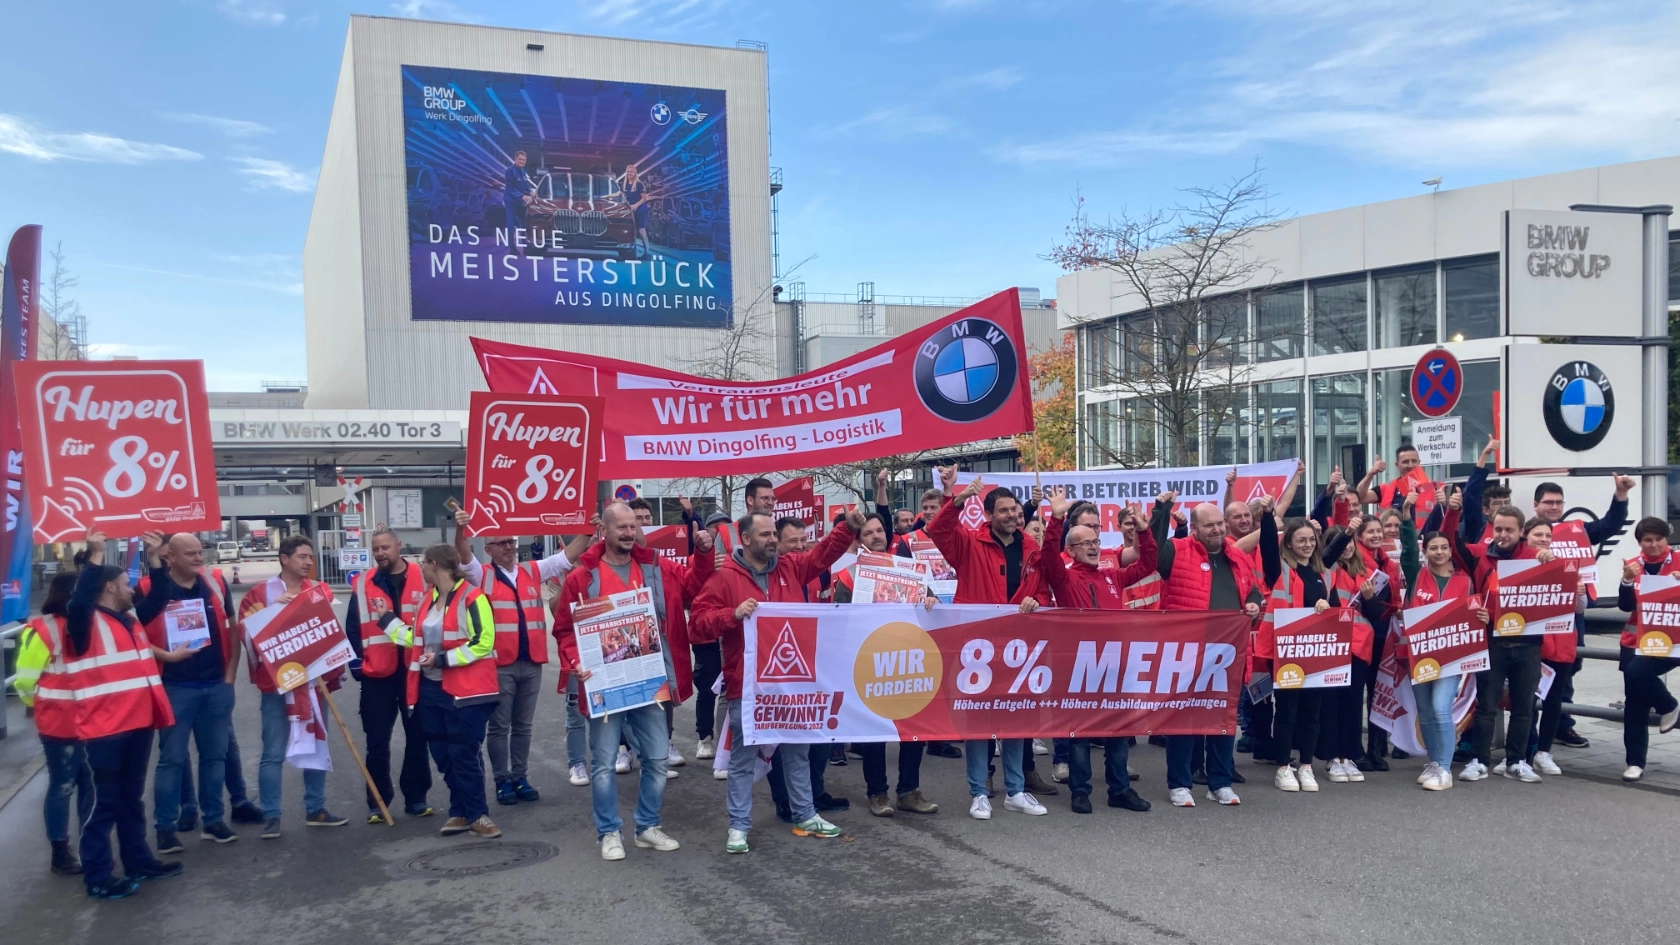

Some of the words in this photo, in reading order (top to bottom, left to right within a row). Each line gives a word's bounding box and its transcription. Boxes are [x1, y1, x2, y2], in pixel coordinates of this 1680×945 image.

[424, 86, 455, 98] BMW
[424, 98, 466, 110] GROUP
[425, 111, 447, 120] Werk
[449, 112, 492, 126] Dingolfing
[429, 224, 480, 246] DAS
[495, 227, 564, 249] NEUE
[1527, 224, 1590, 250] BMW
[430, 252, 715, 288] MEISTERSTÜCK
[1527, 251, 1612, 278] GROUP
[555, 290, 592, 307] AUS
[602, 292, 716, 310] DINGOLFING
[921, 320, 1004, 360] BMW
[669, 369, 848, 394] Vertrauensleute
[1552, 363, 1610, 392] BMW
[45, 385, 183, 430] Hupen
[652, 395, 712, 425] Wir
[720, 395, 772, 422] für
[781, 380, 872, 416] mehr
[224, 422, 276, 438] BMW
[281, 422, 332, 438] Werk
[337, 422, 391, 438] 02.40
[396, 422, 426, 438] Tor
[430, 422, 442, 438] 3
[488, 412, 582, 450] Hupen
[643, 439, 693, 456] BMW
[697, 434, 797, 456] Dingolfing
[812, 418, 886, 446] Logistik
[1417, 424, 1456, 434] Anmeldung
[1417, 442, 1456, 452] Werkschutz
[1430, 451, 1442, 460] frei
[60, 438, 95, 456] für
[103, 435, 188, 498] 8%
[491, 454, 516, 468] für
[516, 454, 577, 504] 8%
[1082, 482, 1162, 498] BETRIEB
[1166, 480, 1219, 496] WIRD
[6, 450, 22, 532] WIR
[773, 502, 793, 510] ABEN
[794, 500, 802, 508] ES
[877, 574, 918, 587] WARNSTREIKS
[1500, 586, 1517, 594] WIR
[1519, 584, 1548, 594] HABEN
[1550, 584, 1562, 592] ES
[1500, 592, 1574, 608] VERDIENT!
[1642, 602, 1662, 611] WIR
[258, 636, 278, 652] WIR
[278, 622, 308, 642] HABEN
[309, 616, 321, 628] ES
[580, 624, 598, 635] JETZT
[599, 614, 645, 630] WARNSTREIKS
[1409, 632, 1426, 644] WIR
[1428, 626, 1456, 638] HABEN
[1458, 622, 1470, 632] ES
[264, 618, 340, 664] VERDIENT!
[1276, 636, 1294, 644] WIR
[1296, 634, 1325, 644] HABEN
[1326, 634, 1338, 642] ES
[1277, 642, 1350, 658] VERDIENT!
[1410, 628, 1484, 656] VERDIENT!
[873, 648, 925, 678] WIR
[1068, 640, 1236, 694] MEHR
[755, 690, 830, 706] SOLIDARITÄT
[866, 676, 934, 698] FORDERN
[954, 698, 990, 710] Höhere
[993, 698, 1036, 712] Entgelte
[1060, 698, 1098, 710] Höhere
[1100, 698, 1227, 711] Ausbildungsvergütungen
[754, 722, 808, 730] TARIFBEWEGUNG
